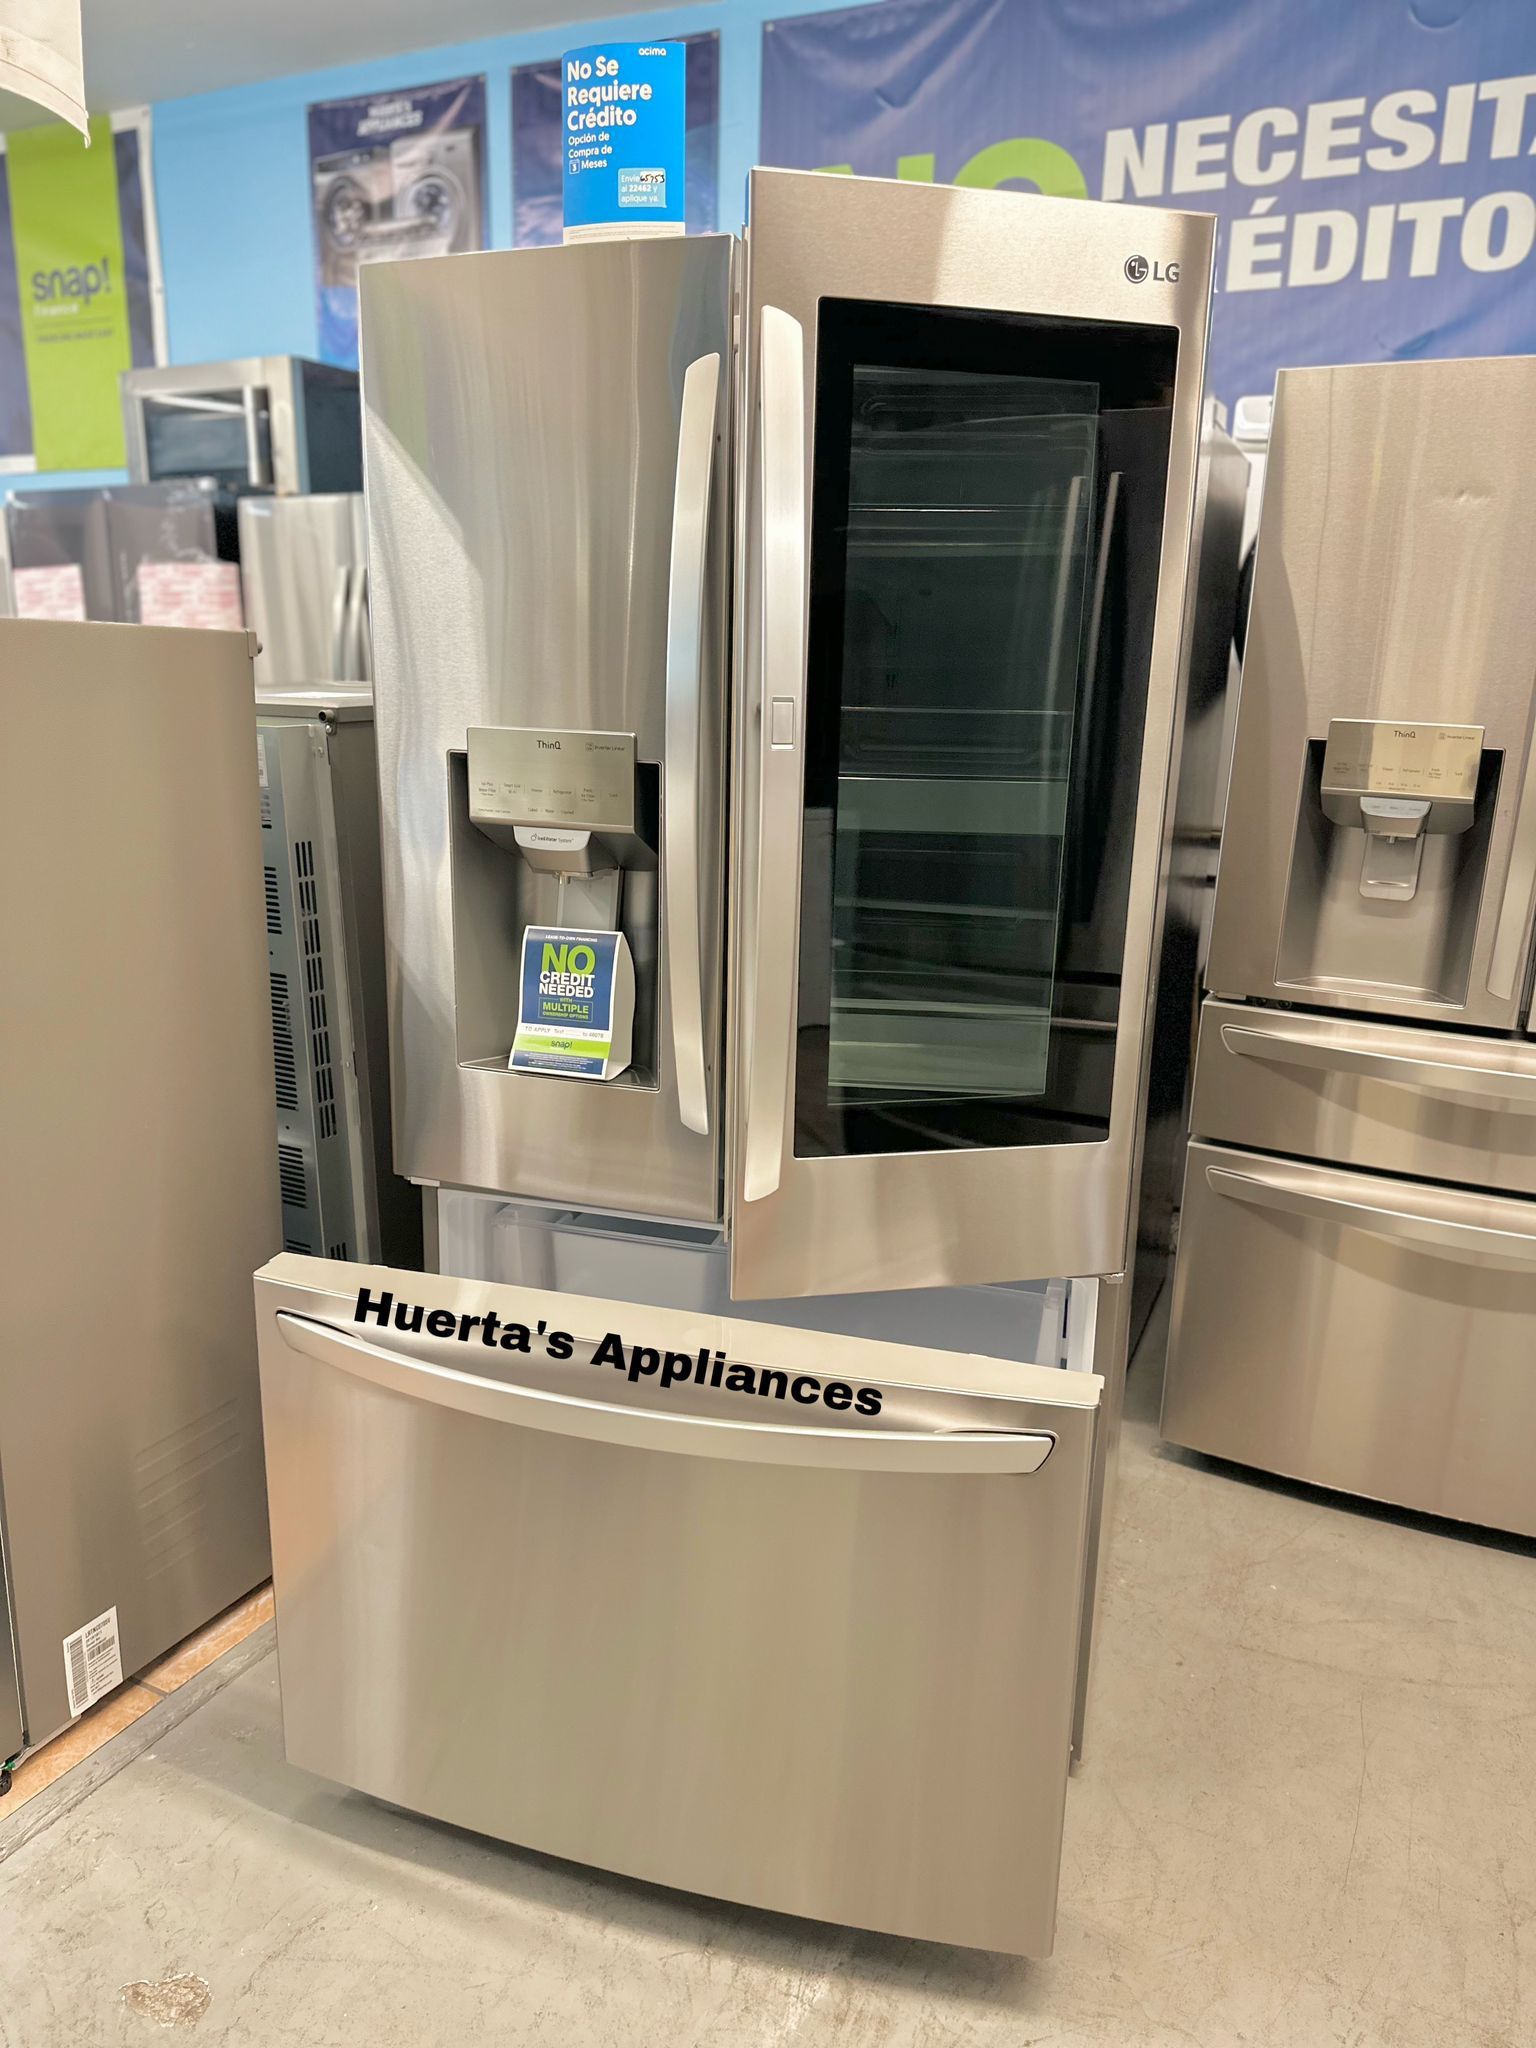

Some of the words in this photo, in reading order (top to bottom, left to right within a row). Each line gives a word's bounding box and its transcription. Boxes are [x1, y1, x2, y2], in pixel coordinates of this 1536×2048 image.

[638, 47, 667, 56] acima
[567, 60, 592, 82] No
[595, 55, 619, 77] Se
[567, 79, 653, 107] Requiere
[567, 105, 637, 131] Crédito
[568, 133, 596, 146] Opción
[598, 131, 610, 141] de
[1102, 74, 1536, 201] NECESIT
[568, 148, 599, 159] Compra
[601, 145, 613, 155] de
[581, 158, 608, 170] Meses
[629, 183, 652, 193] 22462
[1214, 191, 1535, 293] ÉDITO
[1153, 260, 1180, 284] LG
[32, 256, 111, 307] snap!
[1394, 730, 1416, 739] ThinQ
[537, 740, 561, 750] ThinQ
[541, 943, 596, 975] NO
[540, 970, 595, 987] CREDIT
[539, 983, 594, 998] NEEDED
[543, 1002, 589, 1014] MULTIPLE
[551, 1039, 573, 1050] snap!
